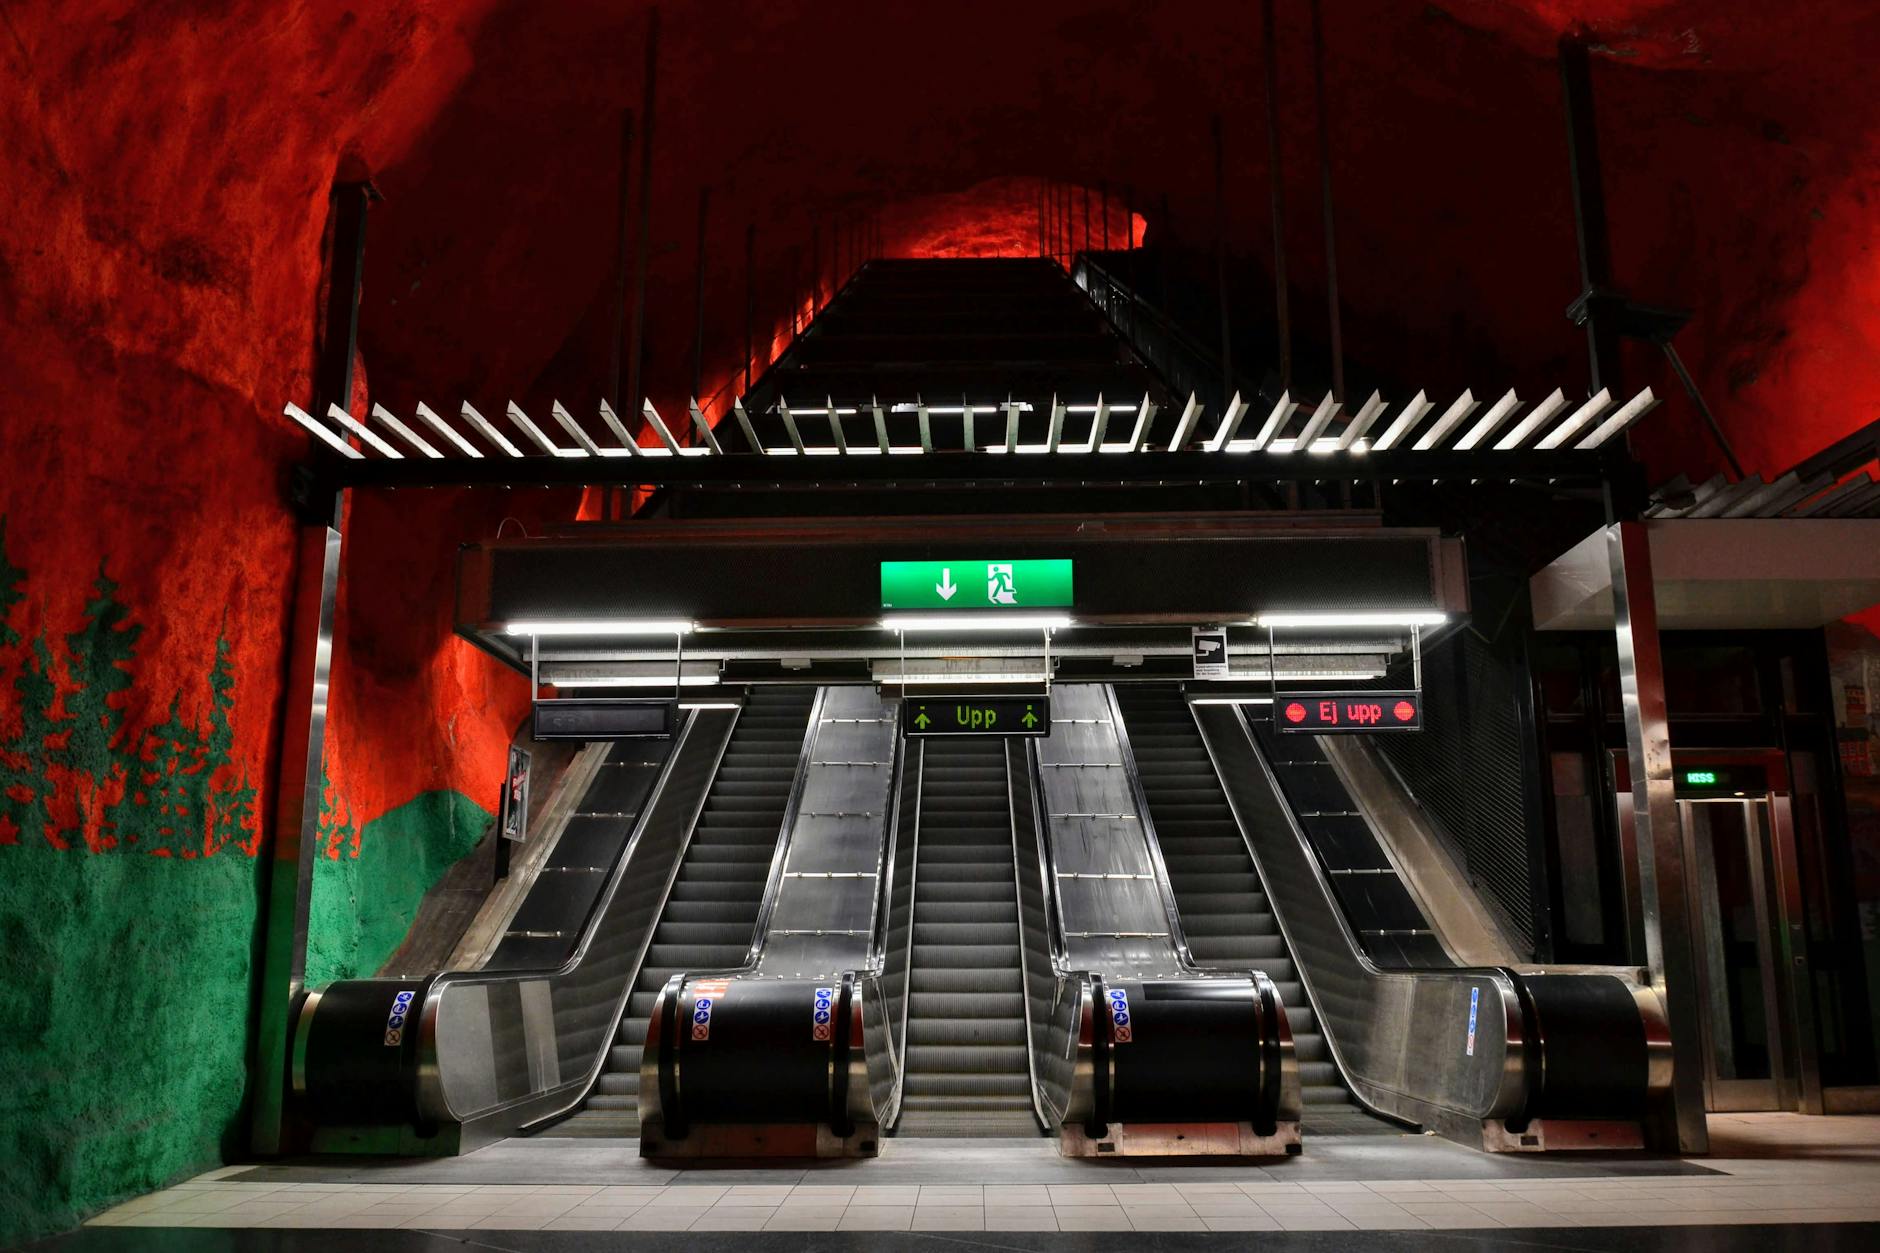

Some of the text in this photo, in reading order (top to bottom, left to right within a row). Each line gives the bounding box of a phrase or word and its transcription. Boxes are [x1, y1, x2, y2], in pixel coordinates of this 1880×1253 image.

[956, 705, 997, 729] Upp
[1319, 701, 1382, 724] Ej upp
[1687, 772, 1715, 784] HISS
